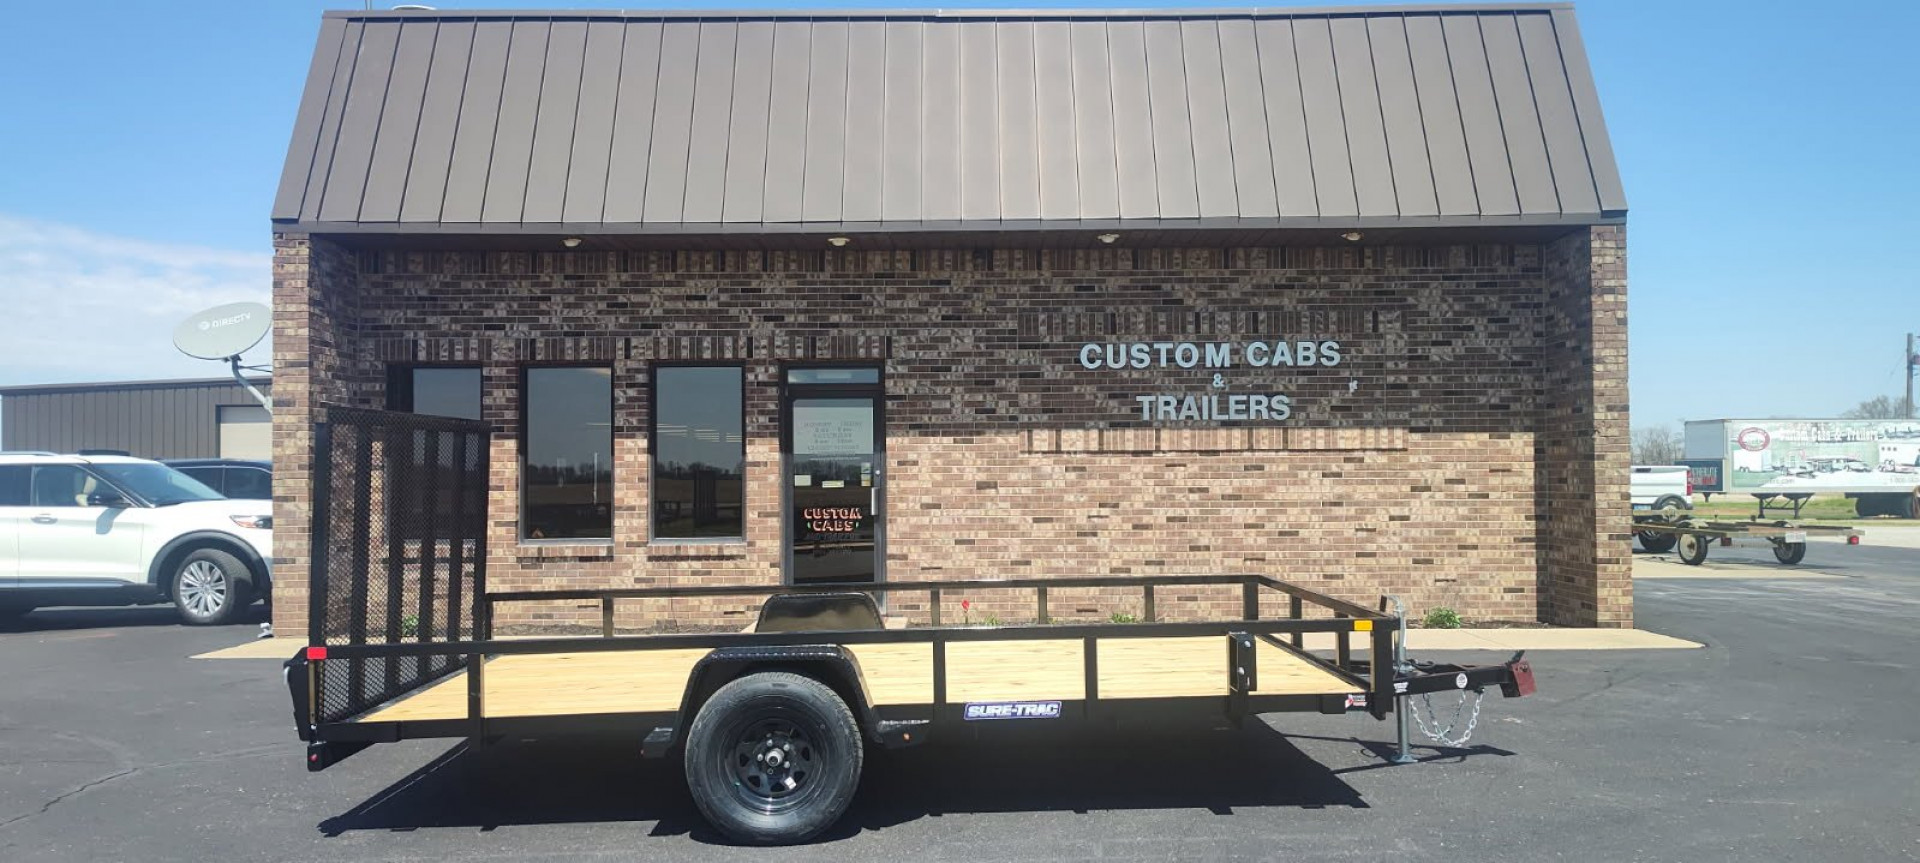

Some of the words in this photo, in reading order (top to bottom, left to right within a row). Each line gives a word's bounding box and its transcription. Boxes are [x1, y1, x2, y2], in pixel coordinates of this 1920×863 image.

[212, 312, 251, 328] DIRECTV
[1080, 342, 1231, 369] CUSTOM
[1246, 341, 1341, 367] CABS
[1212, 373, 1225, 388] &
[1136, 395, 1291, 420] TRAILERS
[804, 507, 863, 519] CUSTOM
[813, 520, 854, 532] CABS
[968, 703, 1059, 718] SURE-TRAC
